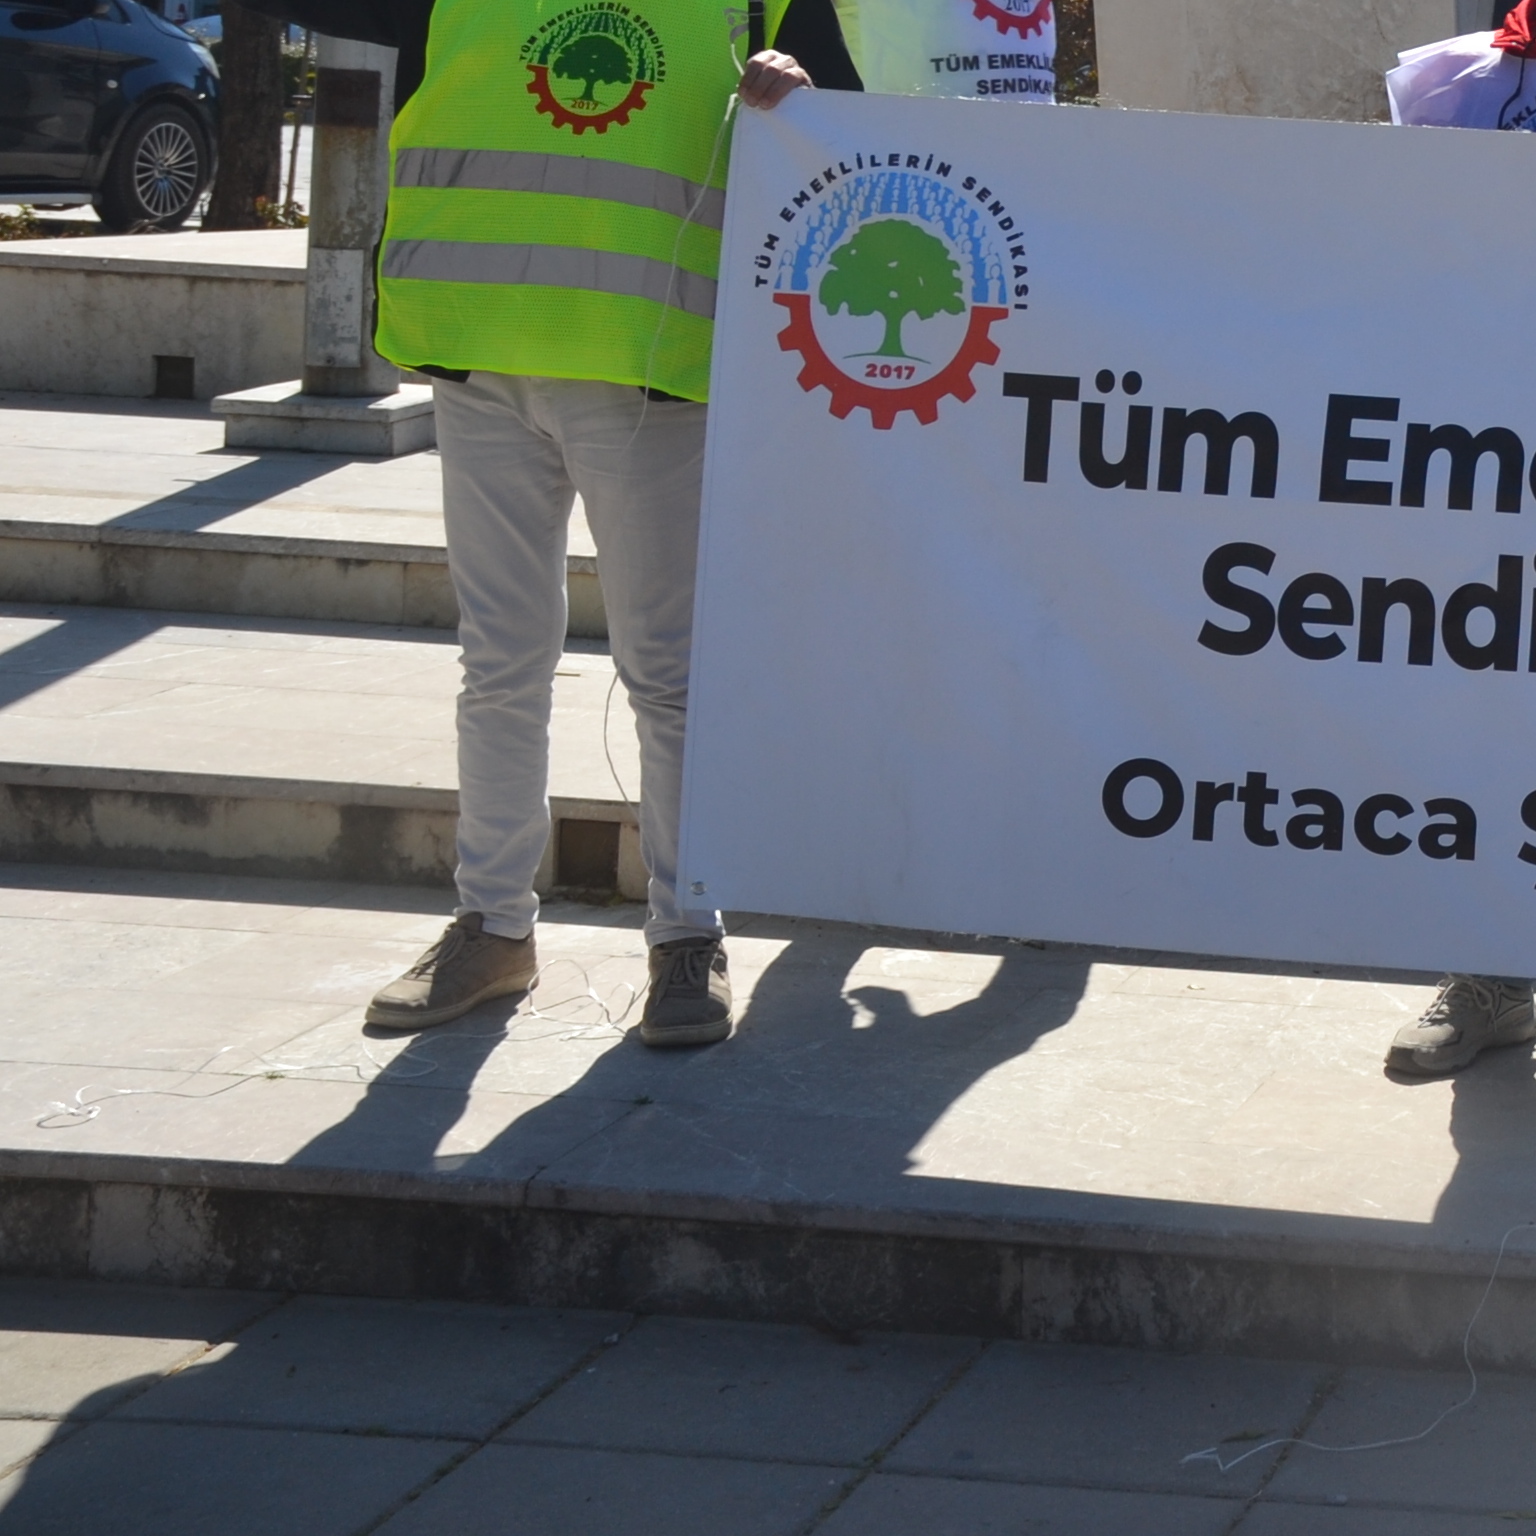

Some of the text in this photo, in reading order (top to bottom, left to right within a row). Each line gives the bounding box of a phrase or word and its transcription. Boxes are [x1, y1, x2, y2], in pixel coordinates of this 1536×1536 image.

[538, 2, 631, 33] EMEKLİLERİN
[632, 15, 667, 83] SENDİKASI
[930, 51, 1056, 73] TÜM EMEKLİL
[571, 99, 599, 111] 2017
[754, 152, 1029, 310] TÜM EMEKLİLERİN SENDİKASI
[865, 363, 916, 380] 2017
[1002, 368, 1279, 499] Tüm
[1102, 757, 1477, 862] Ortaca
